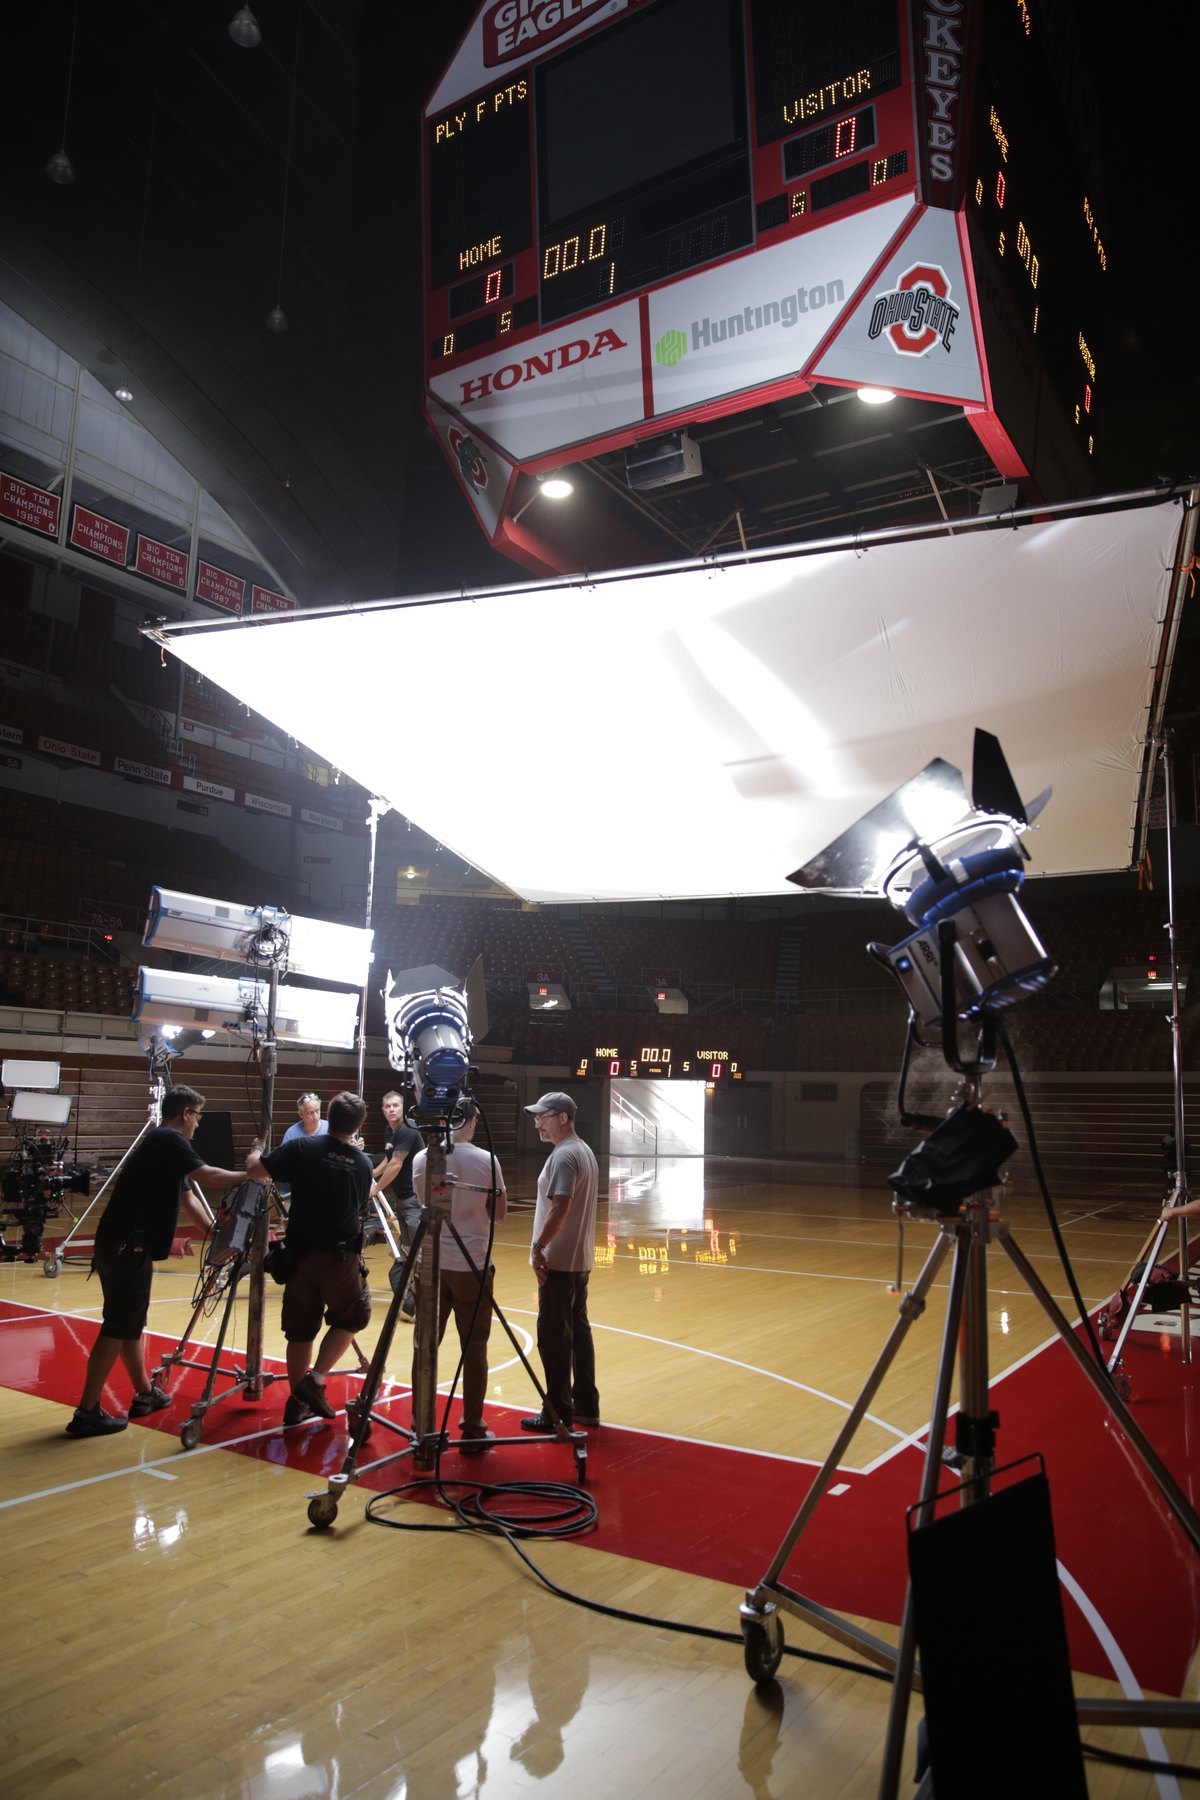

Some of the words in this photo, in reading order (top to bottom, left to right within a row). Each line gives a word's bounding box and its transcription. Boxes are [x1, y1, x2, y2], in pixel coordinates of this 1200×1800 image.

[783, 69, 871, 124] VISITOR
[436, 111, 467, 144] PLY
[476, 102, 486, 122] F
[494, 80, 528, 112] PTS
[835, 116, 856, 159] 0
[872, 158, 888, 186] 0
[791, 191, 806, 218] 5
[459, 235, 502, 270] HOME
[543, 224, 606, 279] 00.0
[485, 270, 502, 304] 0
[609, 262, 615, 294] 1
[500, 311, 511, 333] 5
[691, 279, 845, 351] Huntington
[443, 333, 454, 356] 0
[460, 328, 628, 406] HONDA
[3, 492, 55, 519] CHAMPIONS
[10, 483, 26, 496] BIG
[33, 492, 50, 507] TEN
[16, 509, 40, 525] 1985
[95, 520, 109, 532] NIT
[77, 523, 123, 550] CHAMPIONS
[141, 551, 183, 575] CHAMPIONS
[146, 543, 160, 555] BIG
[166, 551, 180, 563] TEN
[200, 577, 241, 600] CHAMPIONS
[205, 568, 218, 580] BIG
[225, 577, 238, 589] TEN
[260, 592, 271, 603] BIG
[276, 599, 288, 609] TEN
[43, 739, 66, 754] Ohio
[70, 747, 97, 762] State
[117, 760, 141, 775] Penn
[144, 767, 169, 783] State
[196, 781, 224, 797] Purdue
[250, 797, 288, 814] Wisconsin
[309, 812, 338, 828] Maryland
[917, 940, 936, 963] ARRI
[580, 1059, 588, 1069] 0
[595, 1048, 619, 1058] HOME
[641, 1048, 671, 1062] 00.0
[696, 1050, 729, 1060] VISITOR
[610, 1061, 620, 1076] 0
[630, 1060, 638, 1070] 5
[683, 1061, 690, 1071] 5
[712, 1063, 721, 1078] 0
[730, 1062, 738, 1072] 0
